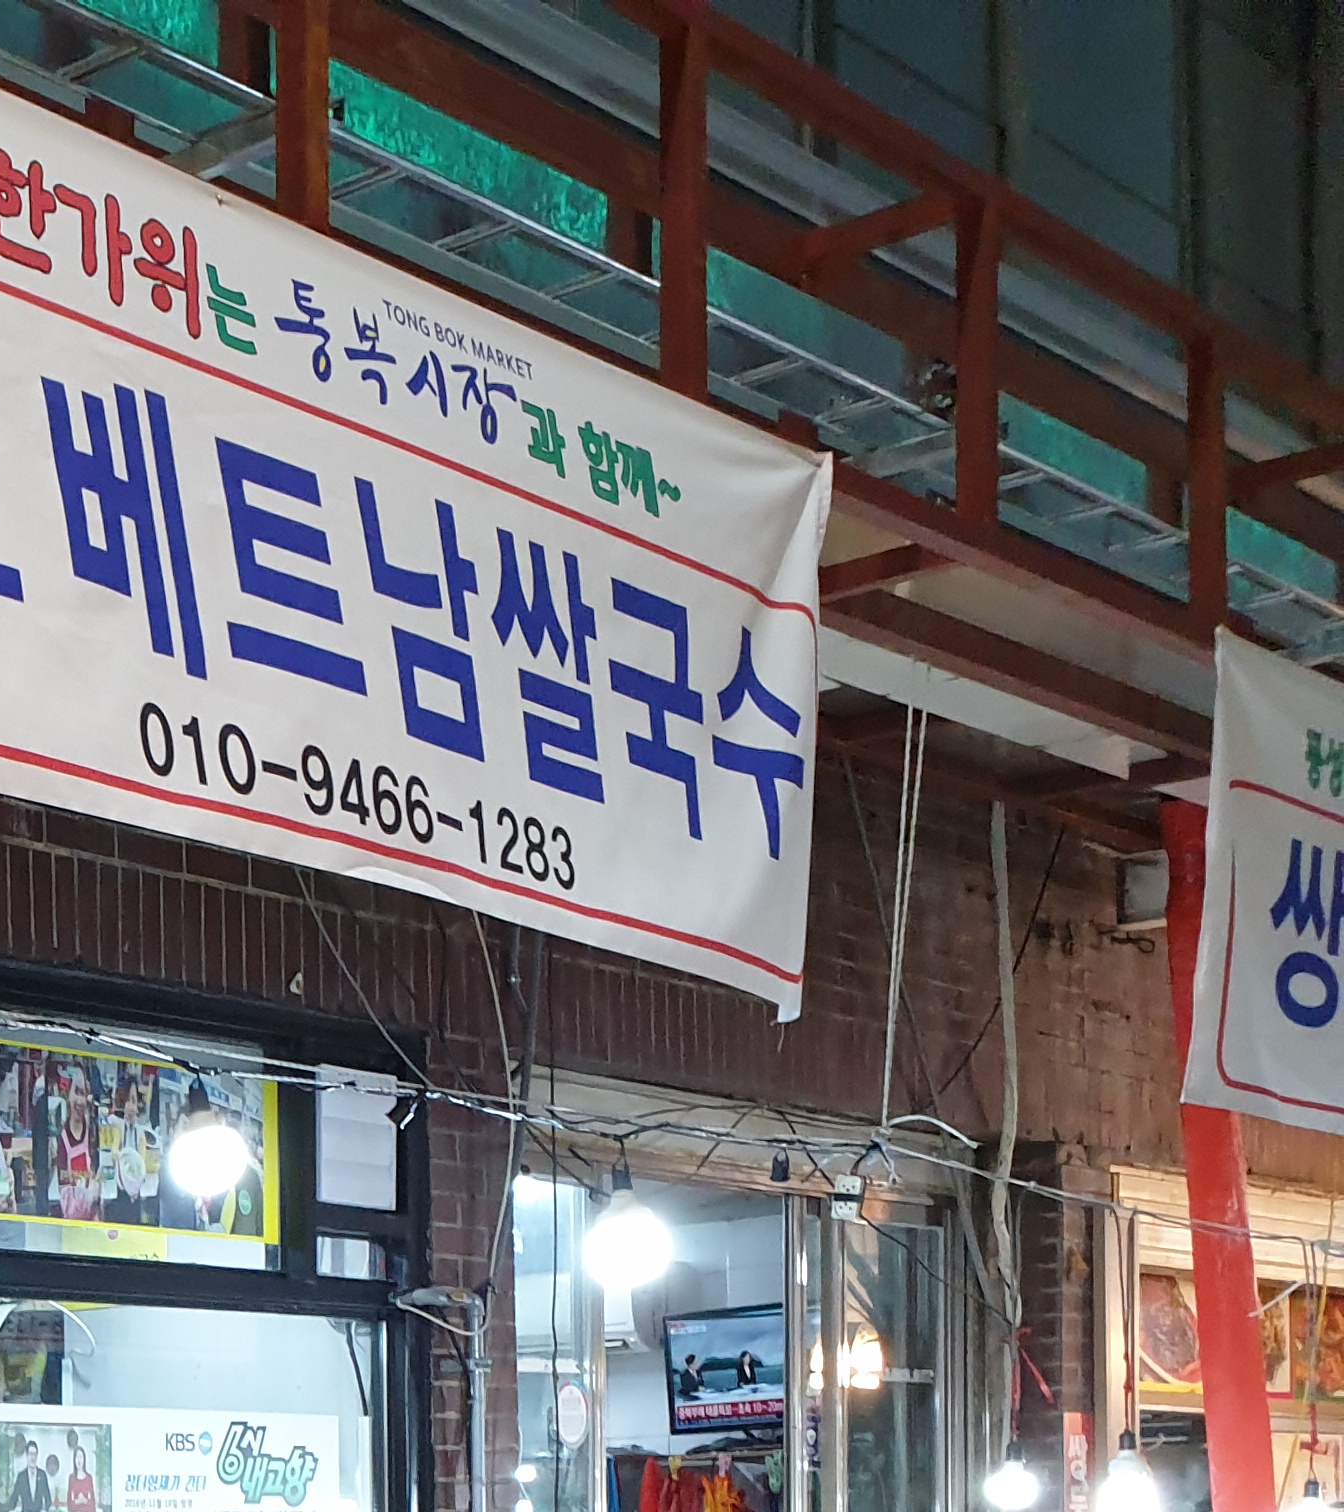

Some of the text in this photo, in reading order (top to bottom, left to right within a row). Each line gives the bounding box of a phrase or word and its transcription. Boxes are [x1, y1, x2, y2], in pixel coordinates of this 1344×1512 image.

[382, 298, 533, 381] TONG BOK MARKET
[41, 375, 805, 863] 베트남쌀국수
[139, 701, 577, 893] 010-9466-1283
[165, 1433, 195, 1452] KBS
